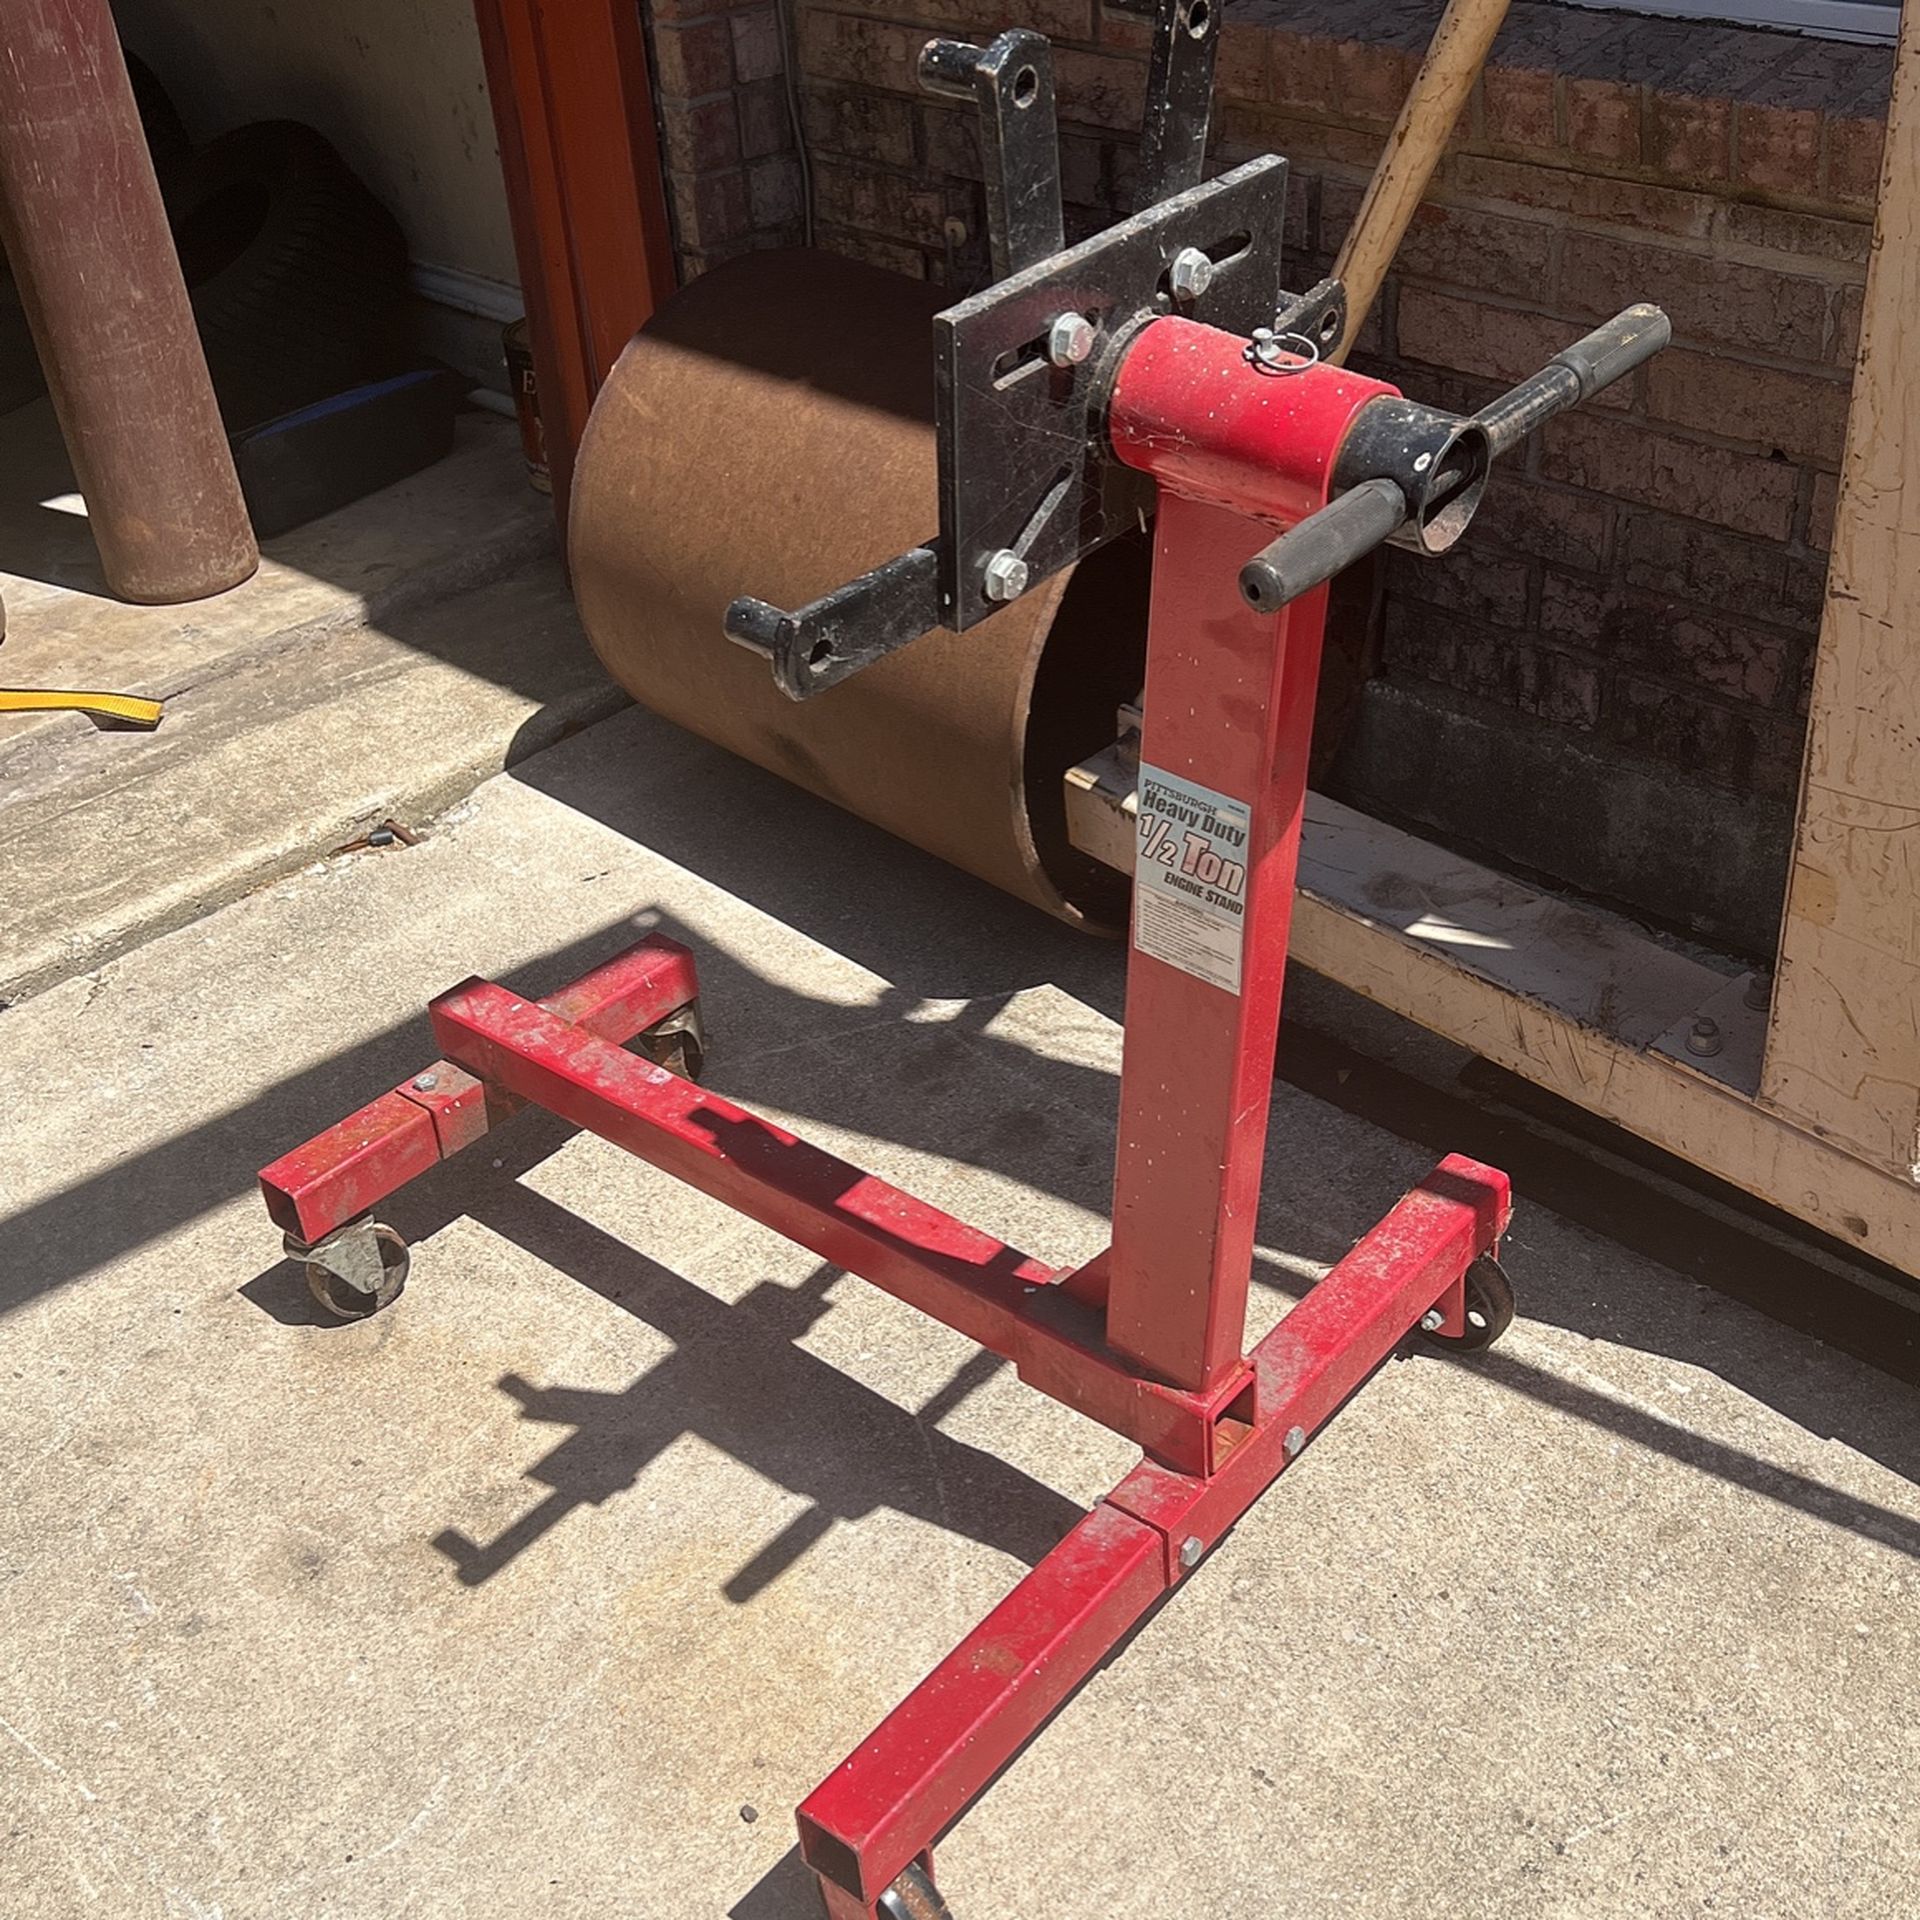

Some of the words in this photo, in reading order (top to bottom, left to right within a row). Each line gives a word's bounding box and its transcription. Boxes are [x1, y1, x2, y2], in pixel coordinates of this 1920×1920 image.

[1143, 778, 1218, 816] PITTSBURGH
[1143, 790, 1200, 829] Heavy
[1201, 814, 1246, 848] Duty
[1139, 812, 1179, 868] 1/2
[1180, 830, 1245, 896] Ton
[1164, 871, 1205, 899] ENGINE
[1205, 887, 1244, 916] STAND
